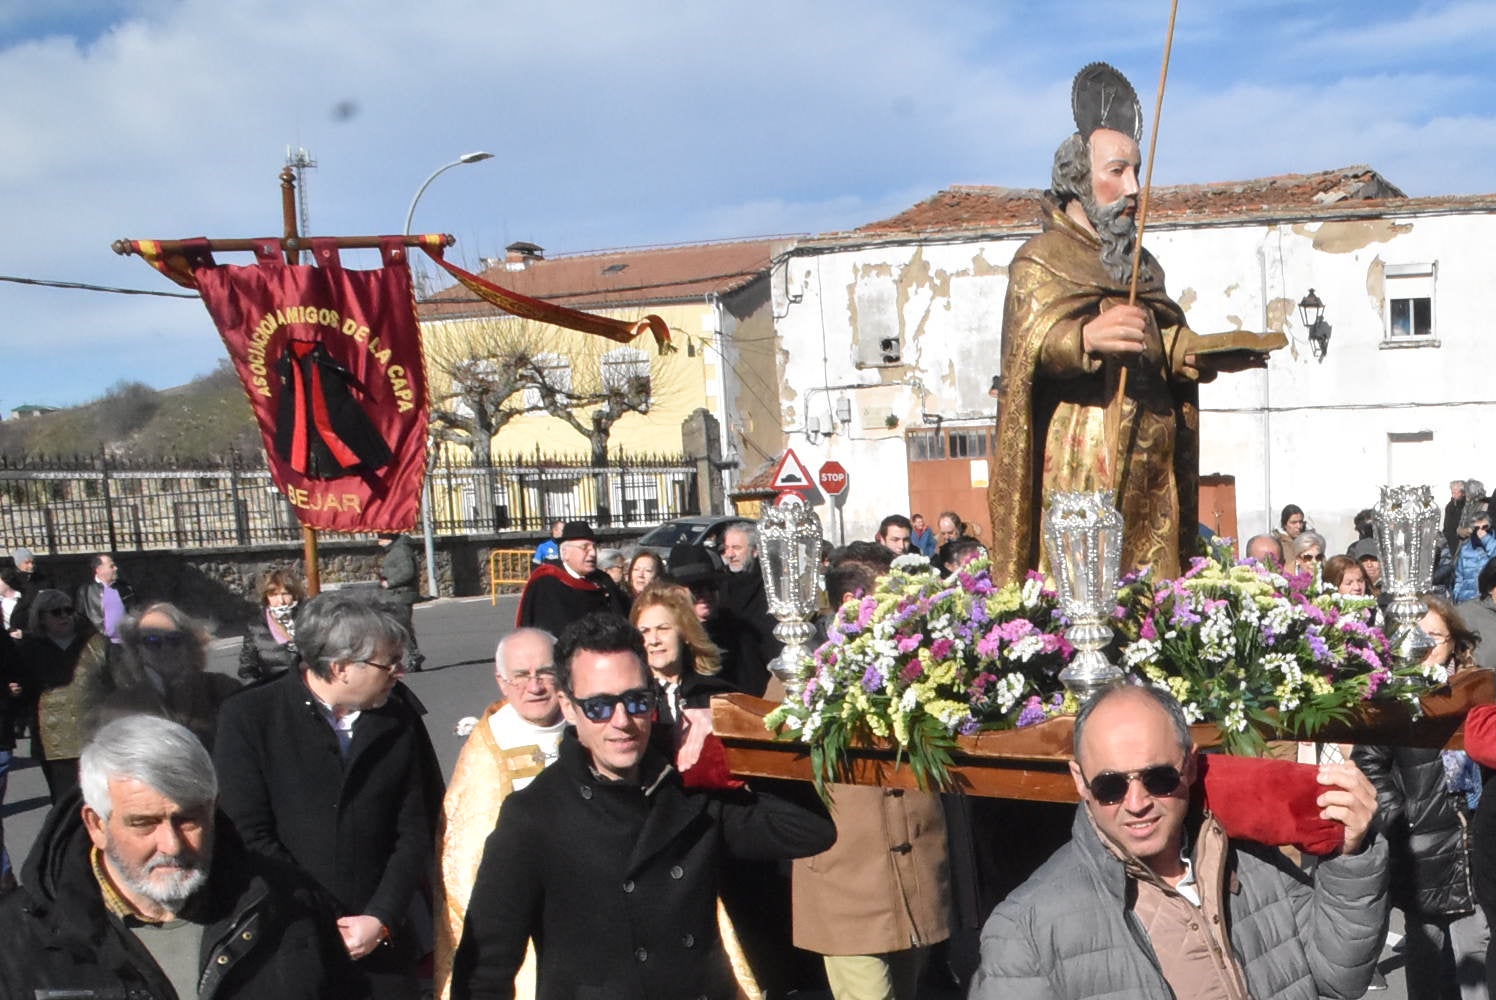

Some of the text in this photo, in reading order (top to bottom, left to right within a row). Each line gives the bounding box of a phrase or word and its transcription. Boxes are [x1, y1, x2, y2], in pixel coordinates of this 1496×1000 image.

[277, 306, 340, 329] AMIGOS
[343, 318, 370, 342] DE
[368, 337, 392, 365] LA
[387, 365, 414, 413] CAPA
[821, 473, 844, 482] STOP
[287, 483, 361, 513] BEJAR
